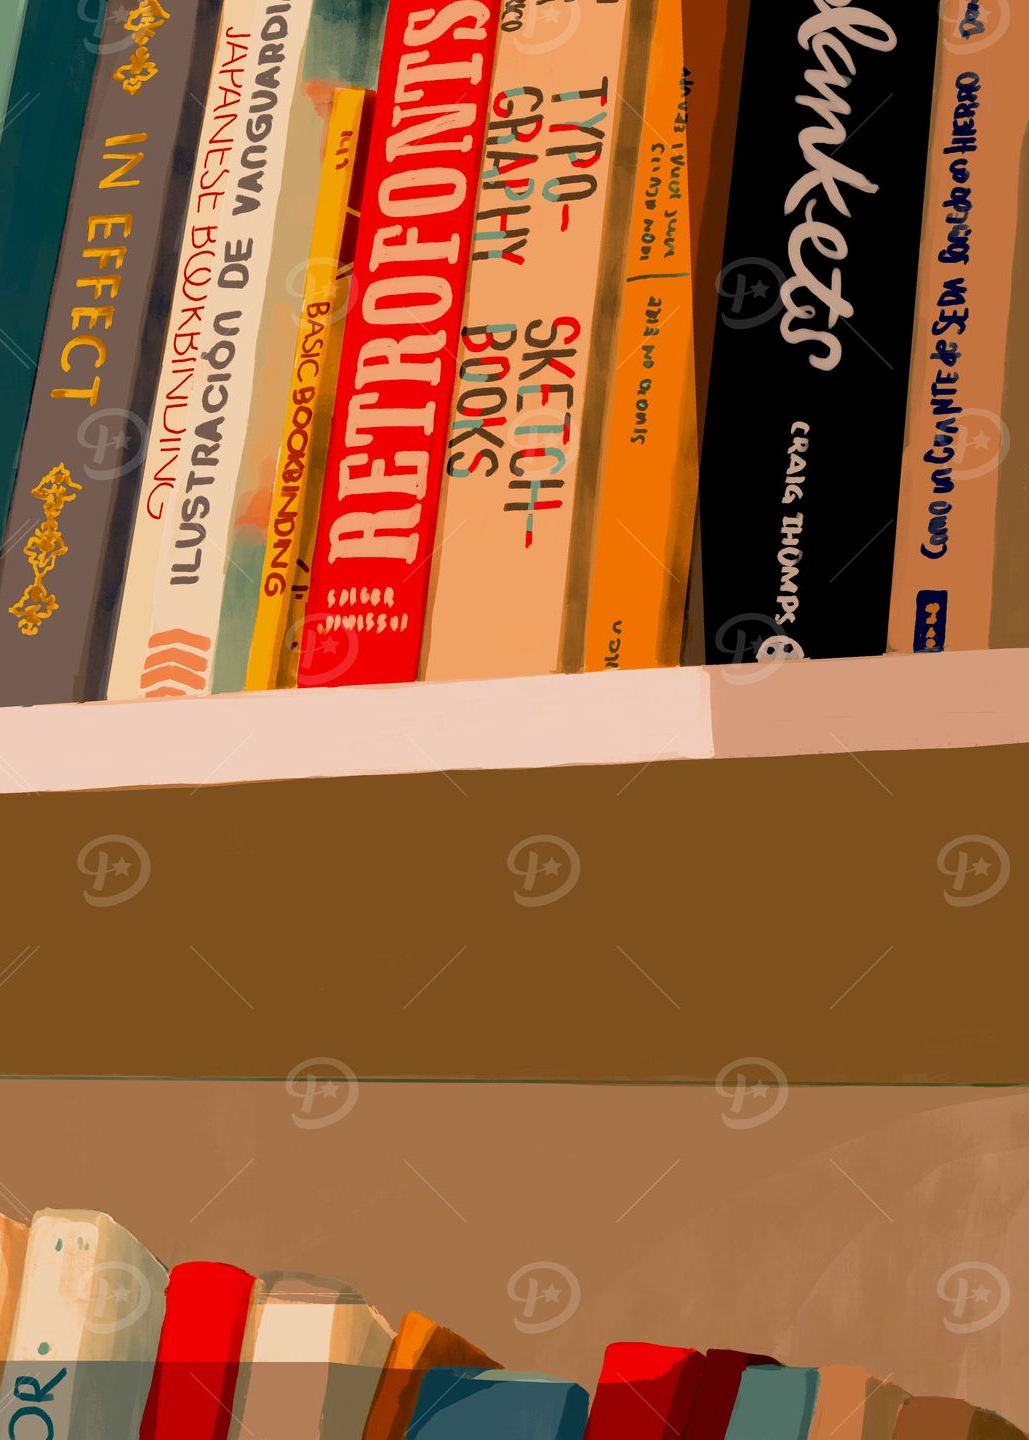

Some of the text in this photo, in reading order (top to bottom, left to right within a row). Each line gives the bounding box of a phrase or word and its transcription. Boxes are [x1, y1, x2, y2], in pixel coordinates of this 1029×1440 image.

[195, 25, 252, 215] JAPANESE
[541, 75, 609, 233] TYPO-
[50, 131, 149, 407] IN EFFECT
[446, 84, 545, 479] GRAPHY BOOKS
[931, 277, 970, 336] SEDA
[294, 300, 332, 383] BASIC
[929, 338, 962, 368] de
[168, 309, 244, 587] ILUSTRACIÓN
[215, 237, 255, 290] DE
[781, 420, 811, 505] CRAIG
[930, 467, 956, 494] un
[920, 499, 954, 561] Como
